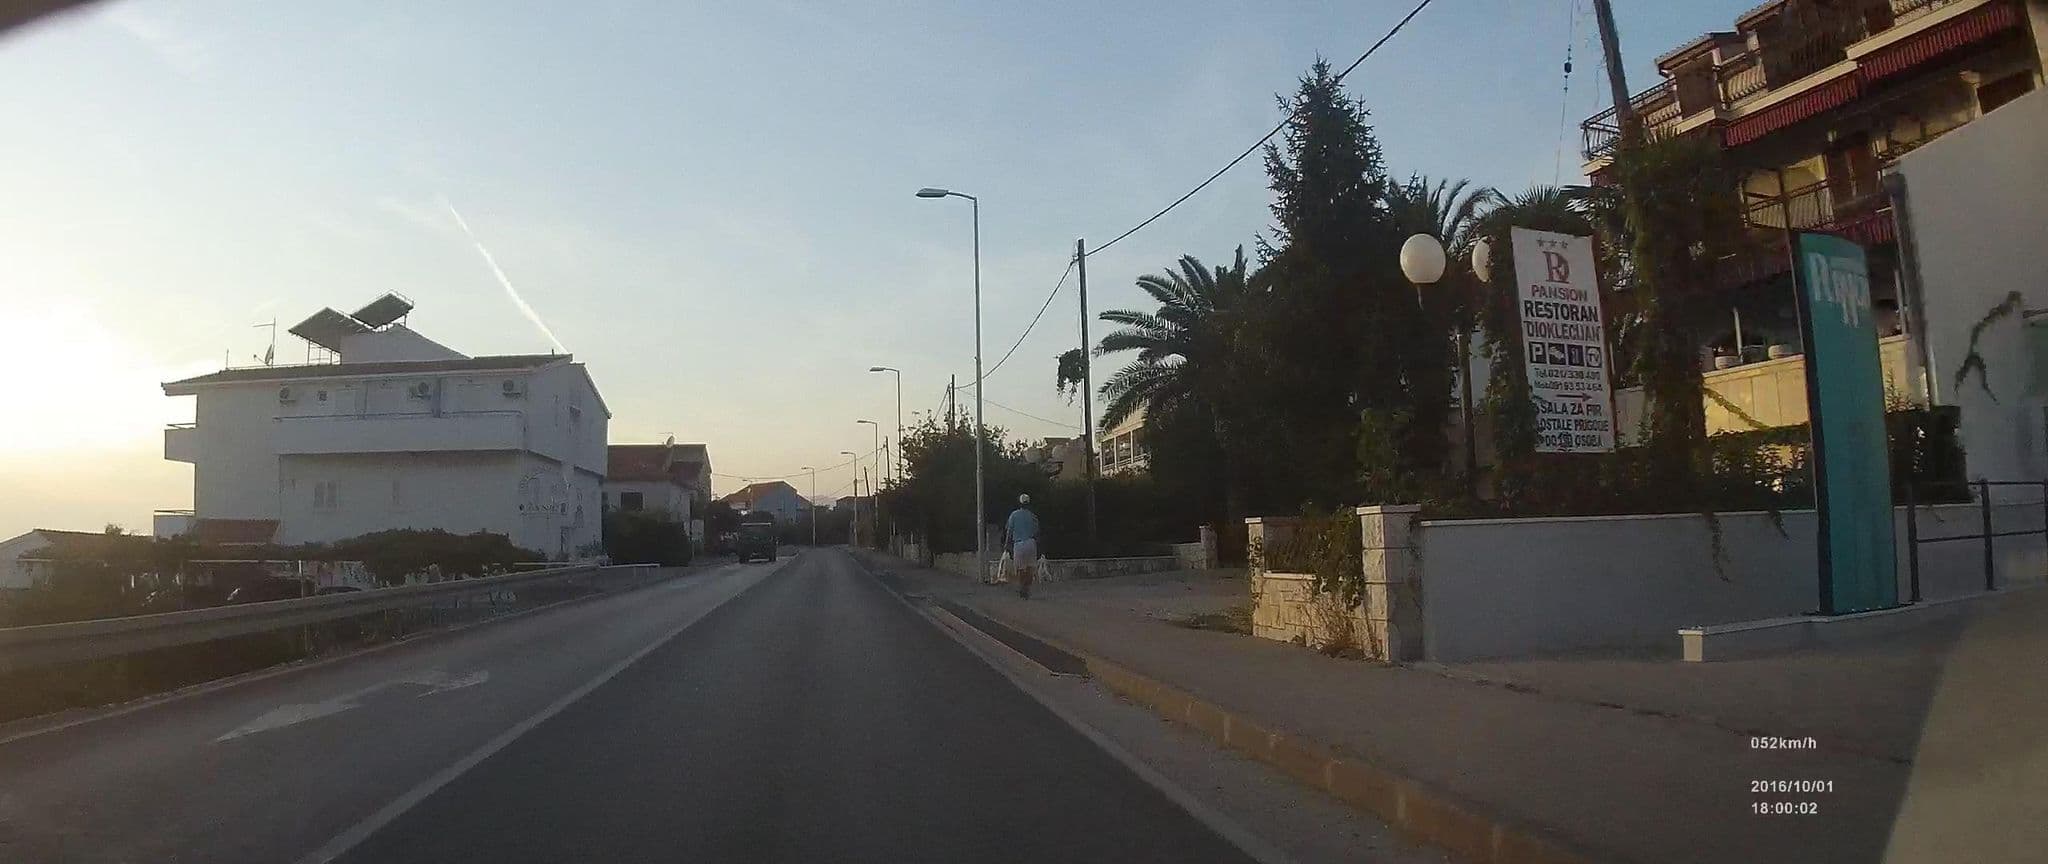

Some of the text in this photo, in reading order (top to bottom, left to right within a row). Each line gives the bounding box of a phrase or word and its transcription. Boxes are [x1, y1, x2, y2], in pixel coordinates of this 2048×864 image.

[1531, 285, 1588, 302] PANSION
[1523, 300, 1599, 323] RESTORAN
[1541, 401, 1569, 415] SALA
[1570, 402, 1584, 416] ZA
